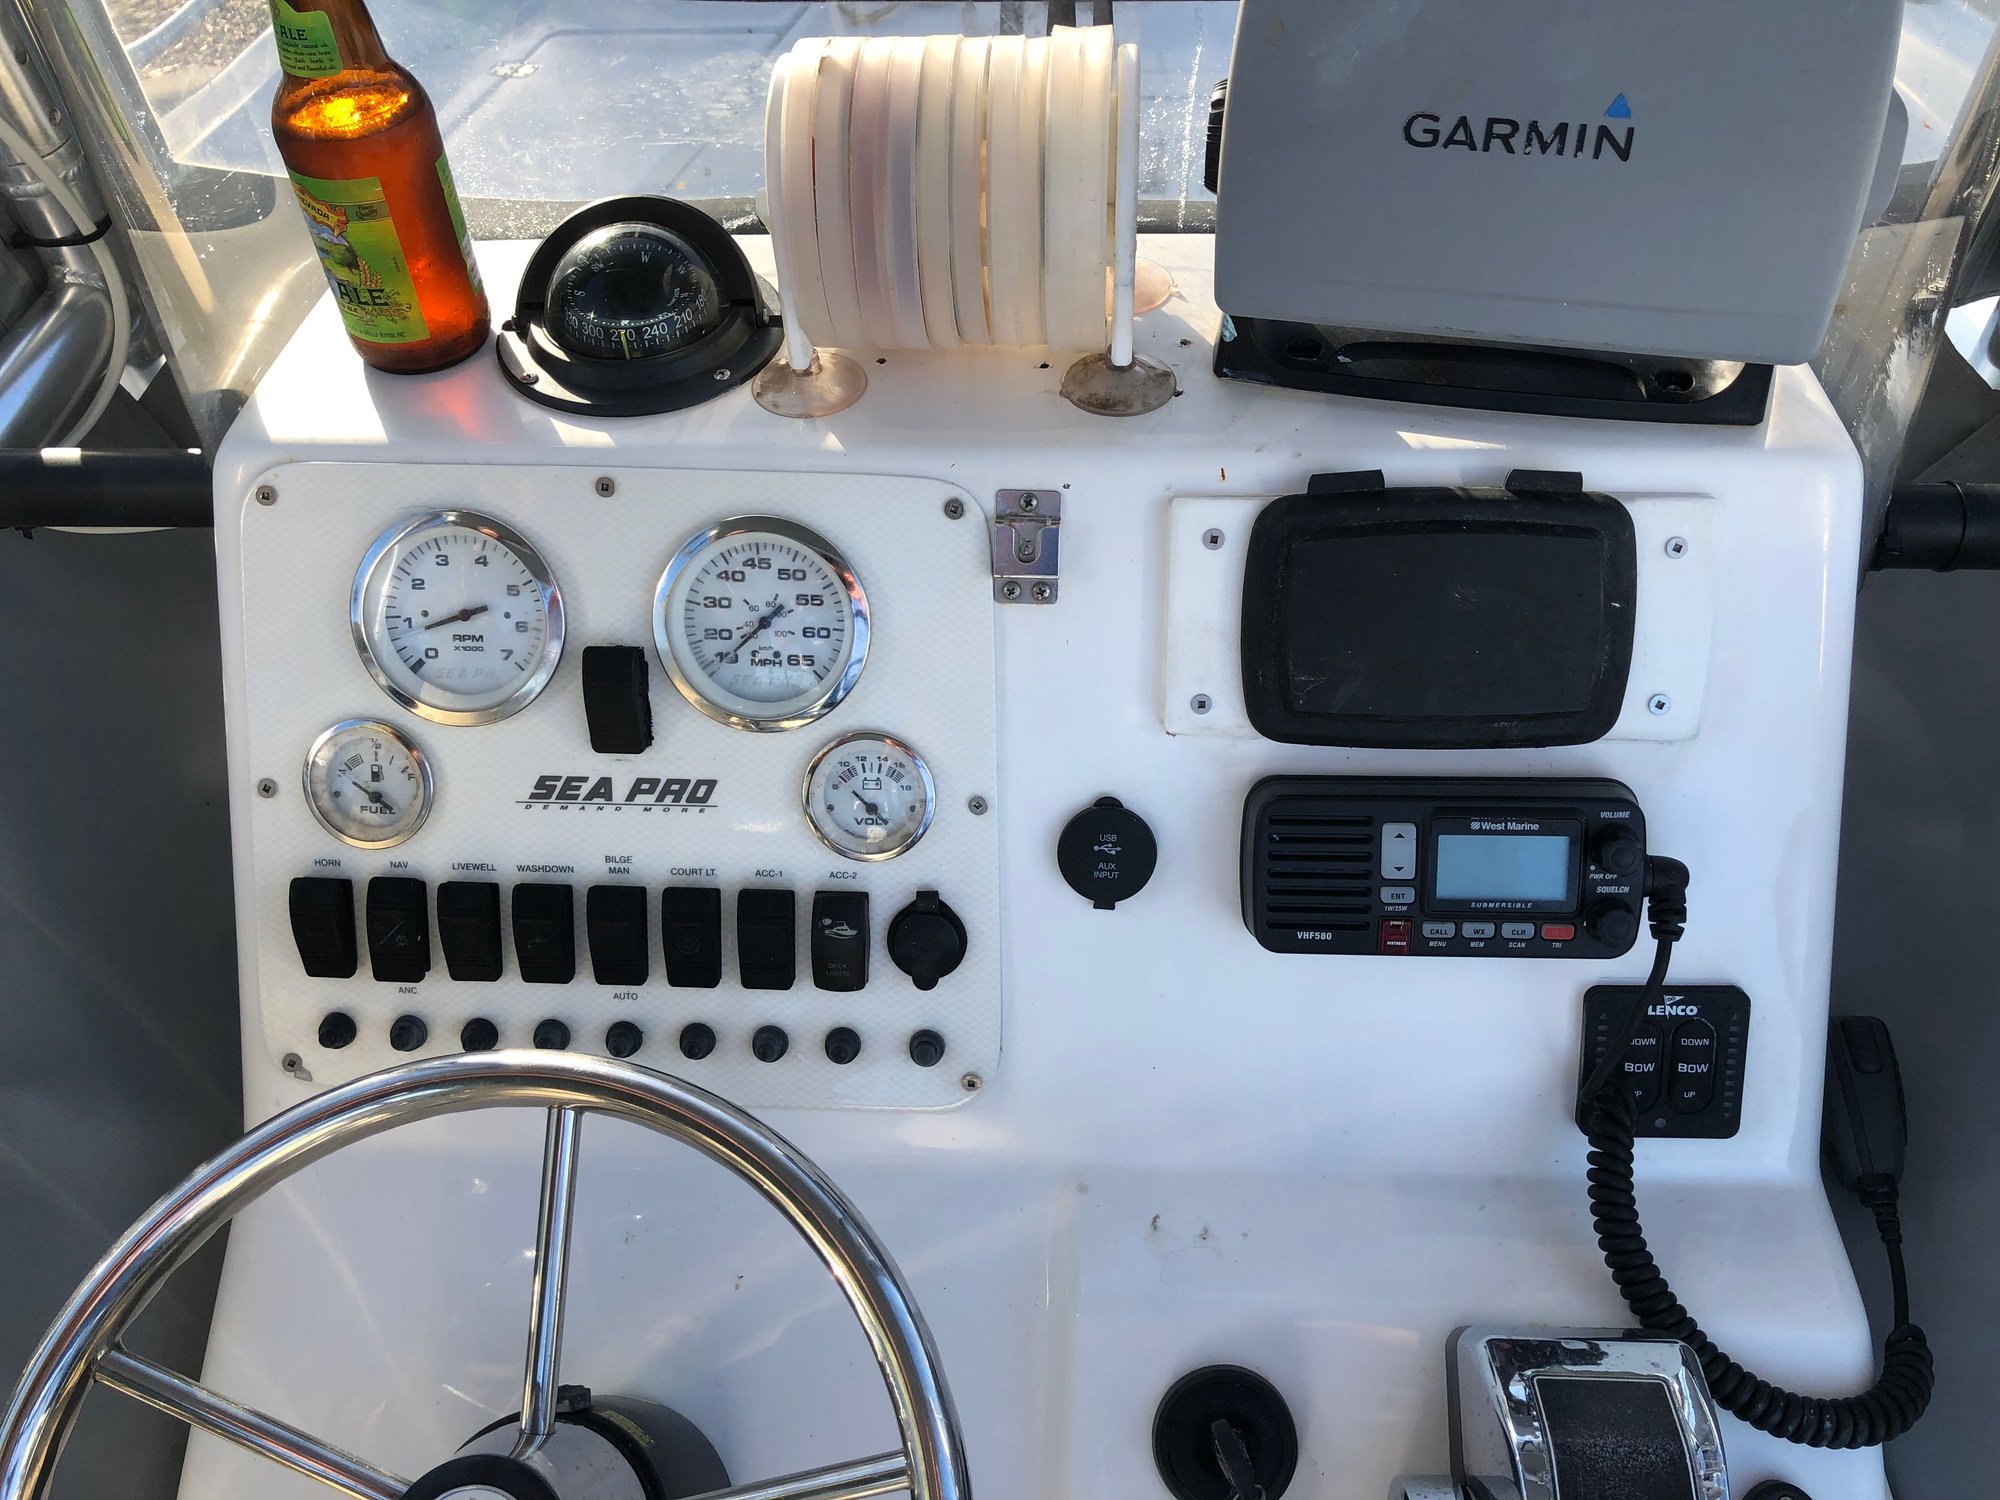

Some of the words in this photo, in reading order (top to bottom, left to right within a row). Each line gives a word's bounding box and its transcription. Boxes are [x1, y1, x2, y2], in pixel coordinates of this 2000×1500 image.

[280, 24, 308, 40] ALE
[1403, 111, 1635, 163] GARMIN
[300, 197, 330, 221] EVADA
[641, 251, 652, 263] W
[590, 260, 605, 272] SW
[336, 280, 390, 306] ALE
[674, 308, 693, 329] 210
[581, 322, 604, 339] 300
[642, 322, 668, 340] 240
[435, 554, 450, 566] 3
[474, 555, 489, 567] 4
[742, 558, 772, 570] 45
[717, 570, 746, 582] 40
[777, 569, 807, 581] 50
[411, 578, 426, 590] 2
[506, 584, 520, 597] 5
[703, 596, 732, 608] 30
[796, 594, 824, 606] 55
[748, 604, 760, 612] 60
[403, 618, 413, 629] 1
[515, 621, 529, 632] 6
[452, 634, 484, 643] RPM
[704, 628, 733, 640] 20
[802, 626, 831, 640] 60
[424, 648, 439, 660] 0
[500, 649, 514, 661] 7
[714, 652, 738, 664] 10
[750, 658, 782, 668] MPH
[787, 655, 816, 667] 65
[528, 774, 614, 802] SEA
[624, 777, 718, 804] PRO
[360, 805, 396, 814] FUEL
[524, 804, 622, 812] DEMAND
[1481, 821, 1505, 830] West
[1507, 821, 1540, 831] Marine
[1099, 834, 1118, 842] USB
[314, 858, 342, 868] HORN
[390, 860, 409, 869] NAV
[604, 856, 633, 864] BILGE
[452, 862, 498, 872] LIVEWELL
[516, 864, 575, 874] WASHDOWN
[608, 866, 630, 874] MAN
[670, 867, 704, 876] COURT
[706, 868, 718, 876] LT.
[754, 869, 784, 878] ACC-1
[828, 872, 858, 880] ACC-2
[1094, 871, 1120, 879] INPUT
[1596, 886, 1630, 894] SQUELCH
[1296, 931, 1332, 940] VHF580
[398, 986, 418, 994] ANC
[612, 992, 639, 1000] AUTO
[1647, 1004, 1698, 1017] LENCO
[1680, 1038, 1710, 1046] DOWN
[1624, 1062, 1656, 1072] BOW
[1678, 1062, 1710, 1073] BOW
